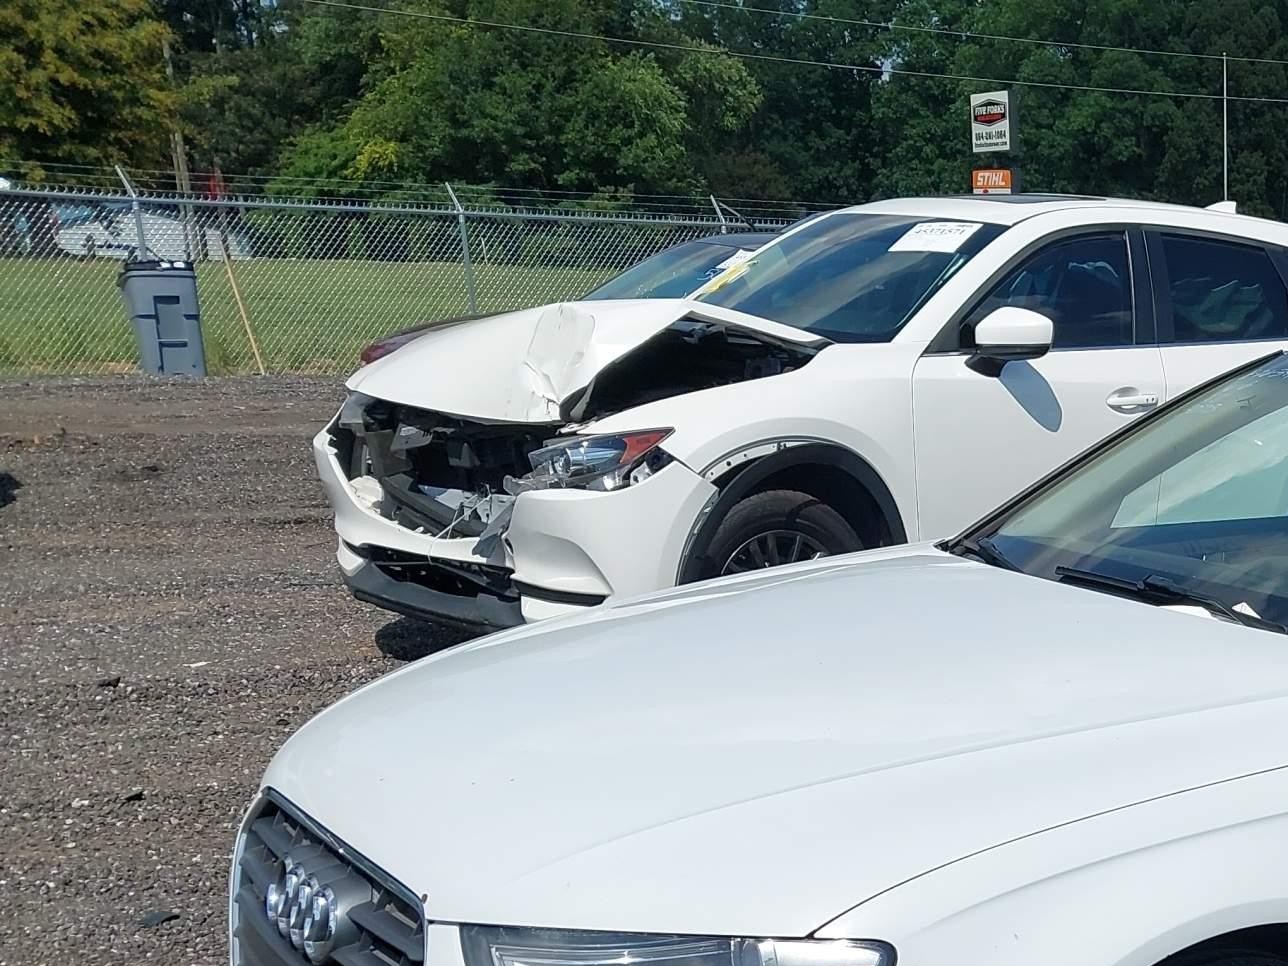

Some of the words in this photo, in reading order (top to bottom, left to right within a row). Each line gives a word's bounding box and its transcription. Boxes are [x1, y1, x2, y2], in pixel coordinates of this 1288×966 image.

[975, 106, 987, 115] FIVE
[987, 105, 1004, 114] FORKS
[976, 172, 1006, 186] STIHL
